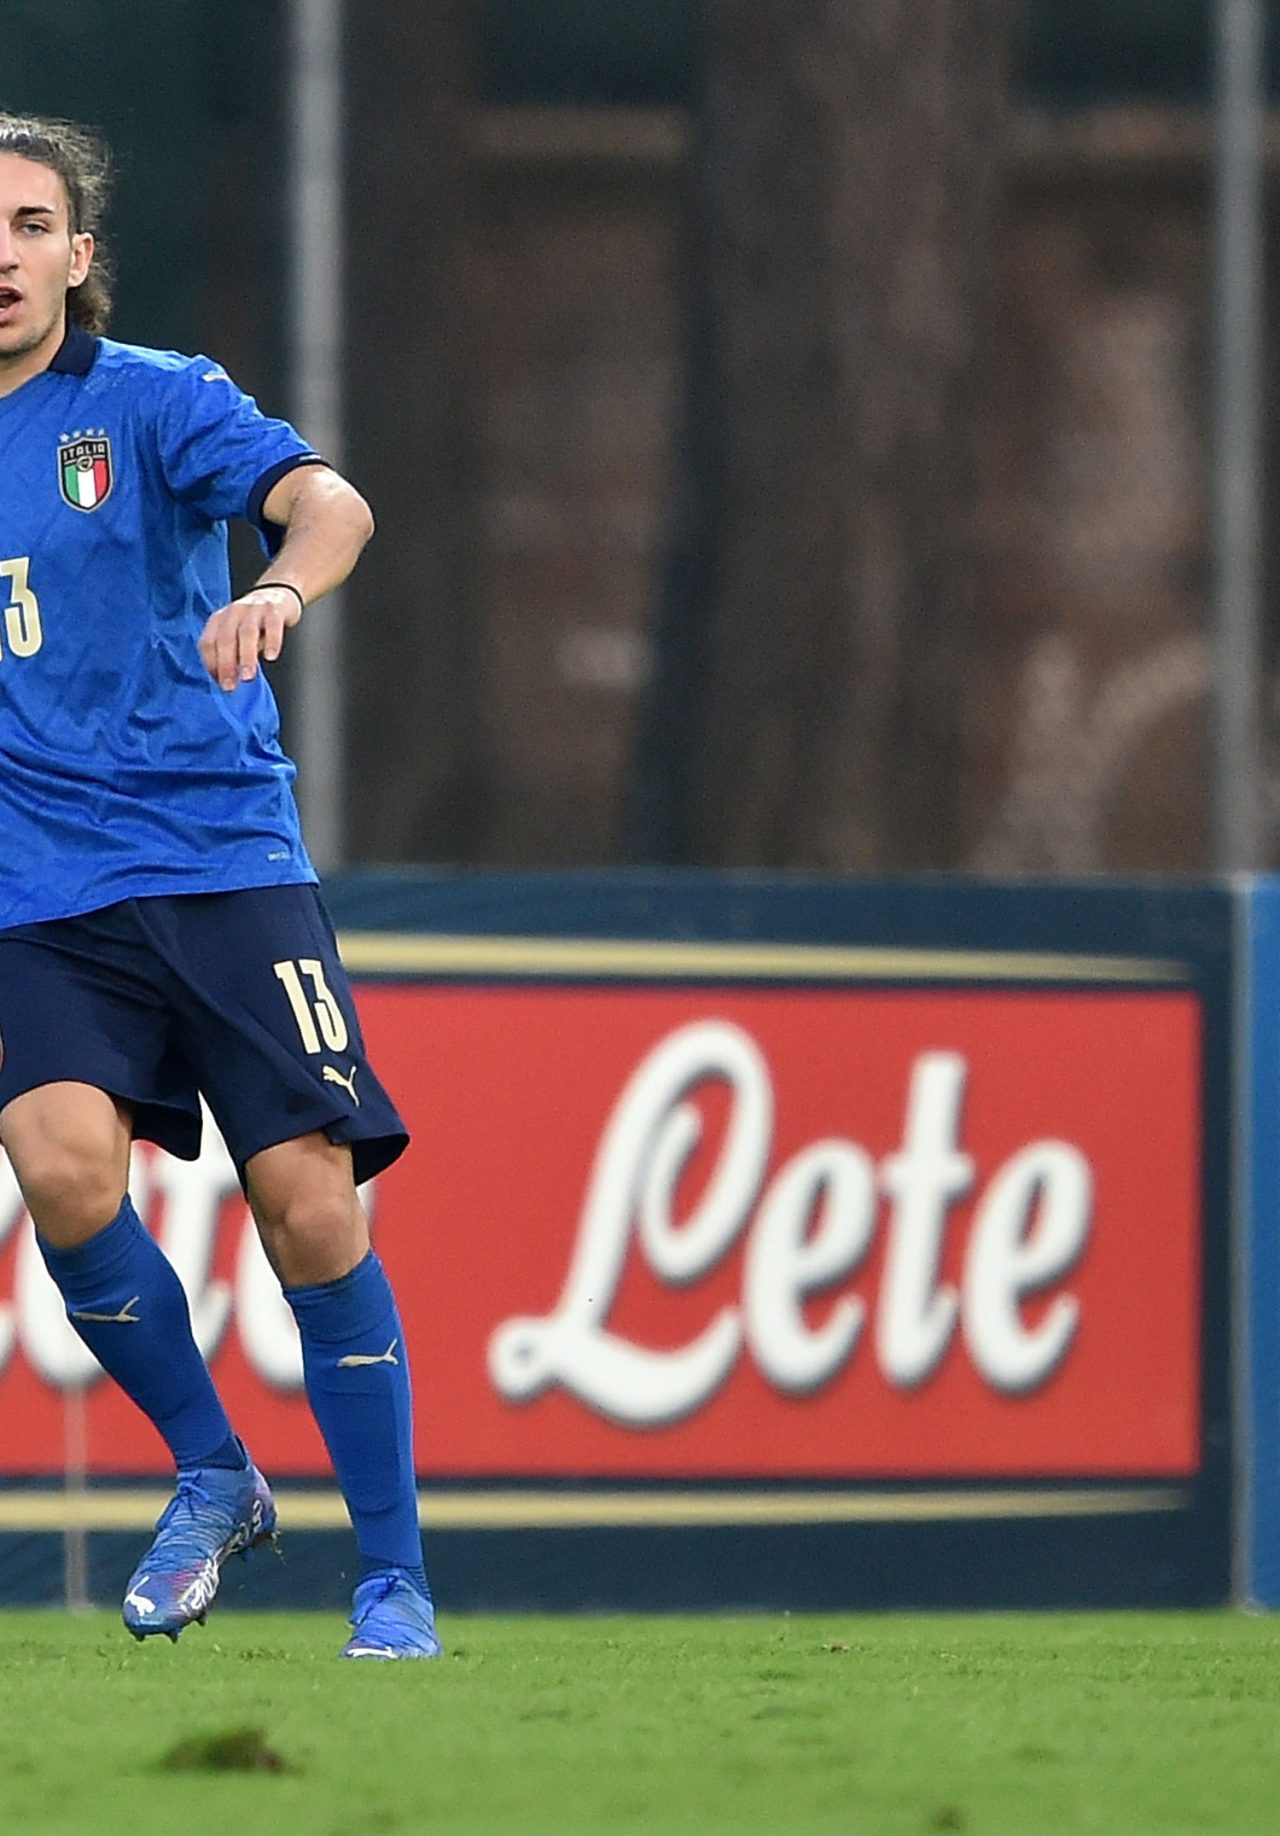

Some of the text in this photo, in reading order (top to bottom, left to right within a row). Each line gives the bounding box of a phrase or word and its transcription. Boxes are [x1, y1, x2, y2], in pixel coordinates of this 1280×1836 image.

[63, 443, 106, 461] ITALIA
[273, 958, 348, 1054] 13
[487, 1018, 1095, 1432] Lete
